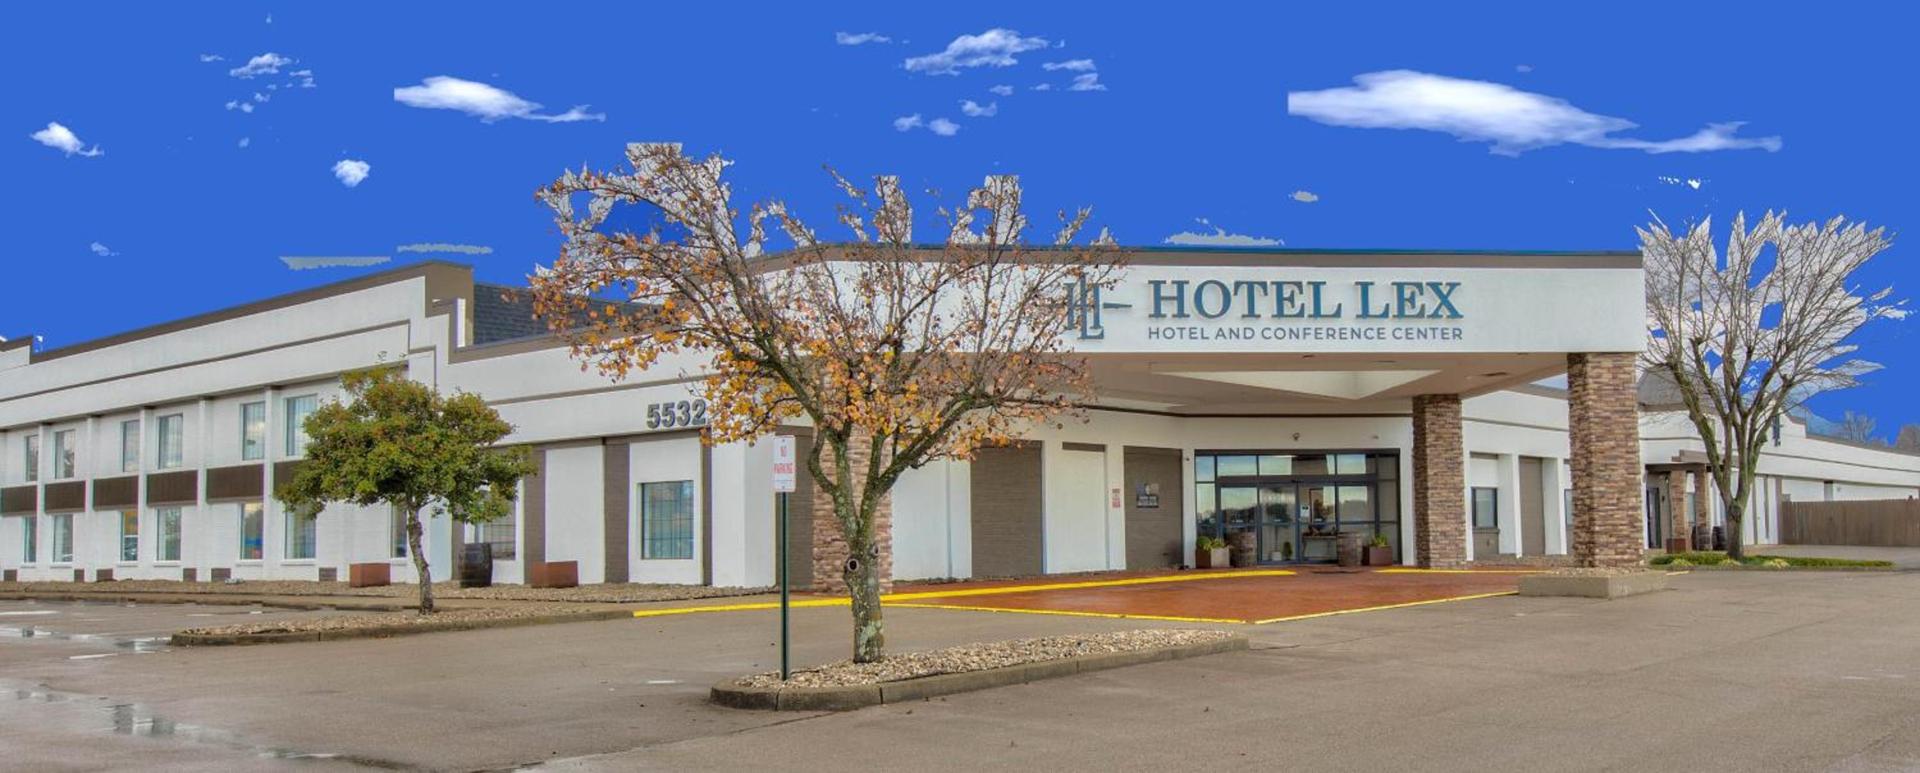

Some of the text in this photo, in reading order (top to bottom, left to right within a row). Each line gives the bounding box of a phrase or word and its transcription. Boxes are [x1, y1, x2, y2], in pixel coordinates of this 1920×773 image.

[1148, 280, 1464, 319] HOTEL LEX
[1148, 327, 1463, 341] HOTEL AND CONFERENCE CENTER
[647, 399, 706, 429] 5532
